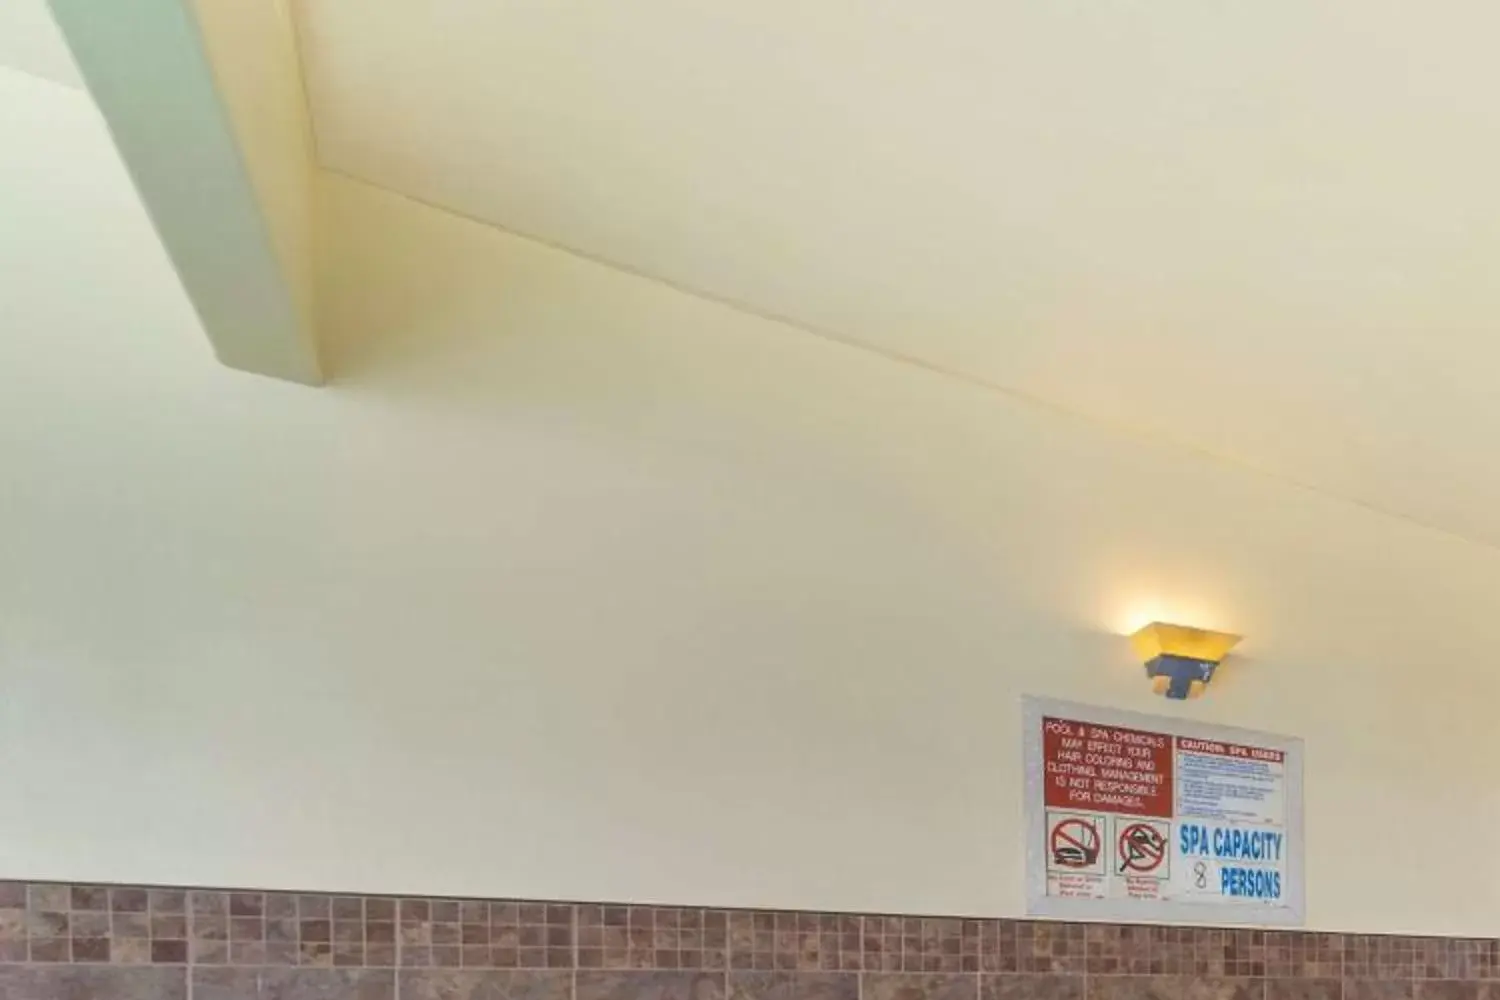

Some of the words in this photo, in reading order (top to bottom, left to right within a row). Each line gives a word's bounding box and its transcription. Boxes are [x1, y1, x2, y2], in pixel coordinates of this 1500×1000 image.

[1046, 721, 1073, 735] POOL
[1091, 729, 1109, 740] SPA
[1113, 731, 1165, 748] CHEMICALS
[1061, 738, 1083, 749] MAY
[1127, 746, 1152, 758] YOUR
[1230, 746, 1248, 756] SPA
[1251, 749, 1282, 761] USERS
[1057, 750, 1081, 762] HAIR
[1085, 754, 1133, 768] COLORING
[1134, 760, 1155, 771] AND
[1055, 776, 1067, 787] IS
[1069, 777, 1090, 790] NOT
[1093, 780, 1158, 797] RESPONSIBLE
[1101, 768, 1164, 784] MANAGEMENT
[1069, 789, 1091, 802] FOR
[1180, 823, 1209, 855] SPA
[1214, 827, 1283, 860] CAPACITY
[1194, 861, 1207, 889] 8
[1222, 867, 1281, 899] PERSONS
